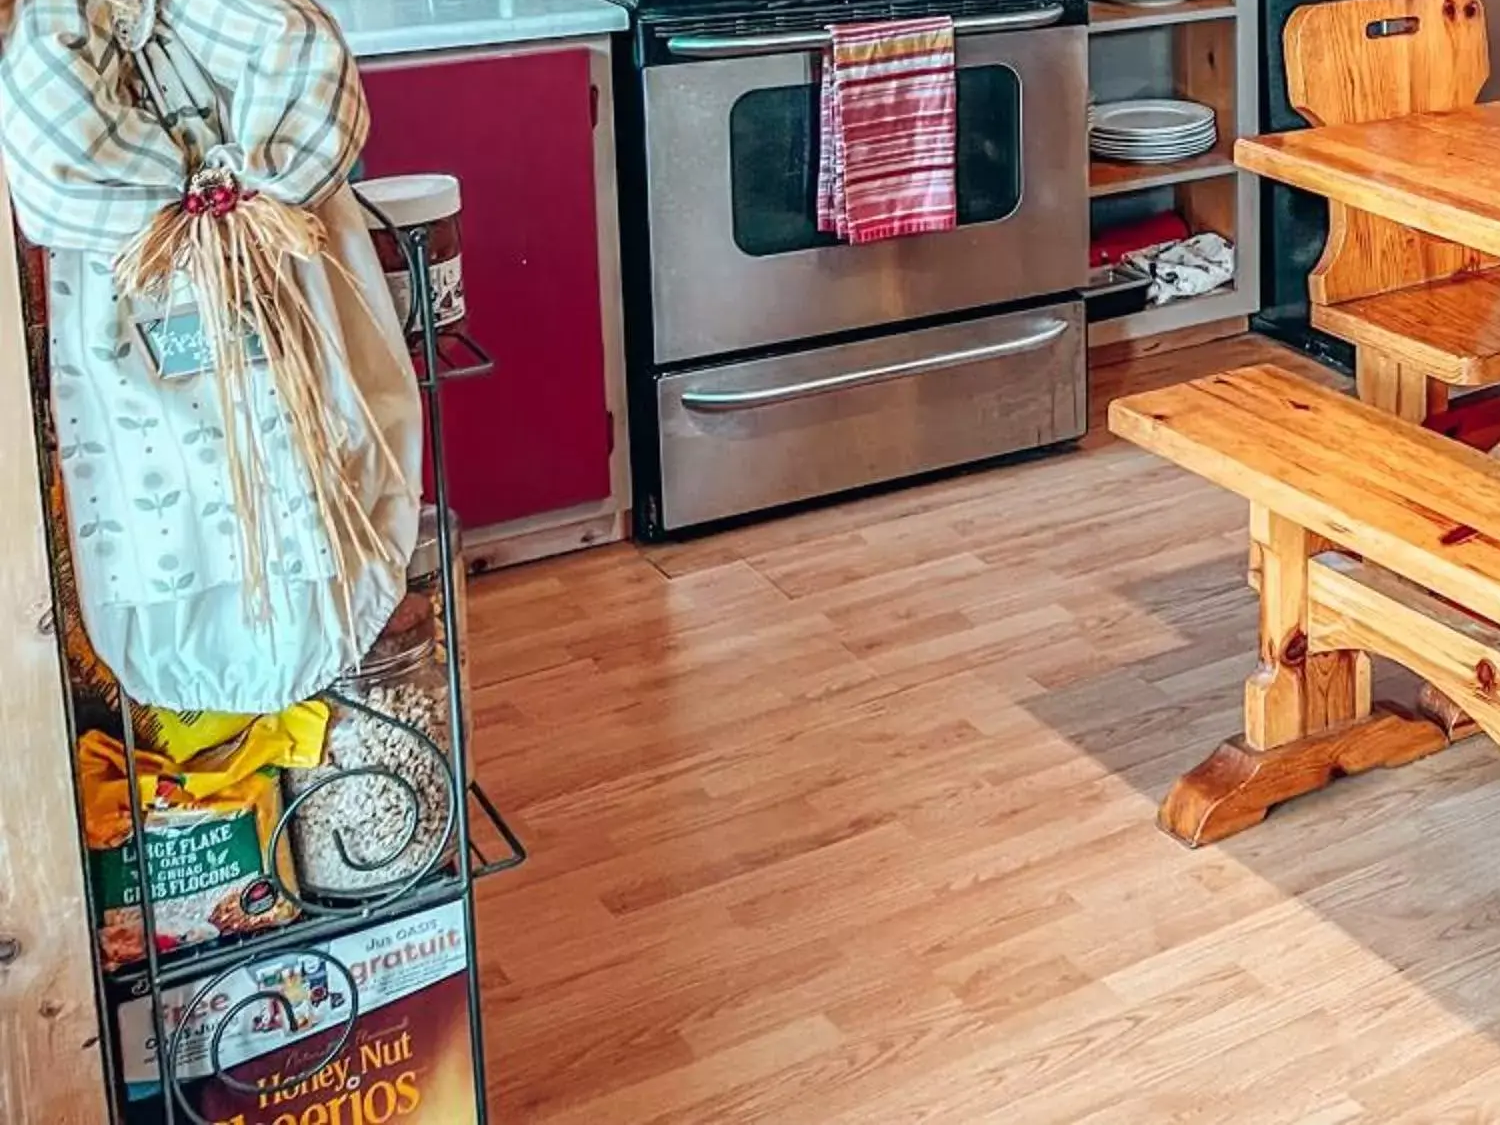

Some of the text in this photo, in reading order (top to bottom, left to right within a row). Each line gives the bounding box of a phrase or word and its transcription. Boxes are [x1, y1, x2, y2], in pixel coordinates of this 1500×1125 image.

[180, 824, 233, 854] FLAKE
[160, 852, 197, 868] OATS
[169, 860, 241, 896] FLOCONS
[350, 926, 461, 986] gratuit
[365, 937, 393, 952] Jus
[256, 1056, 351, 1109] Honey
[359, 1030, 414, 1074] Nut
